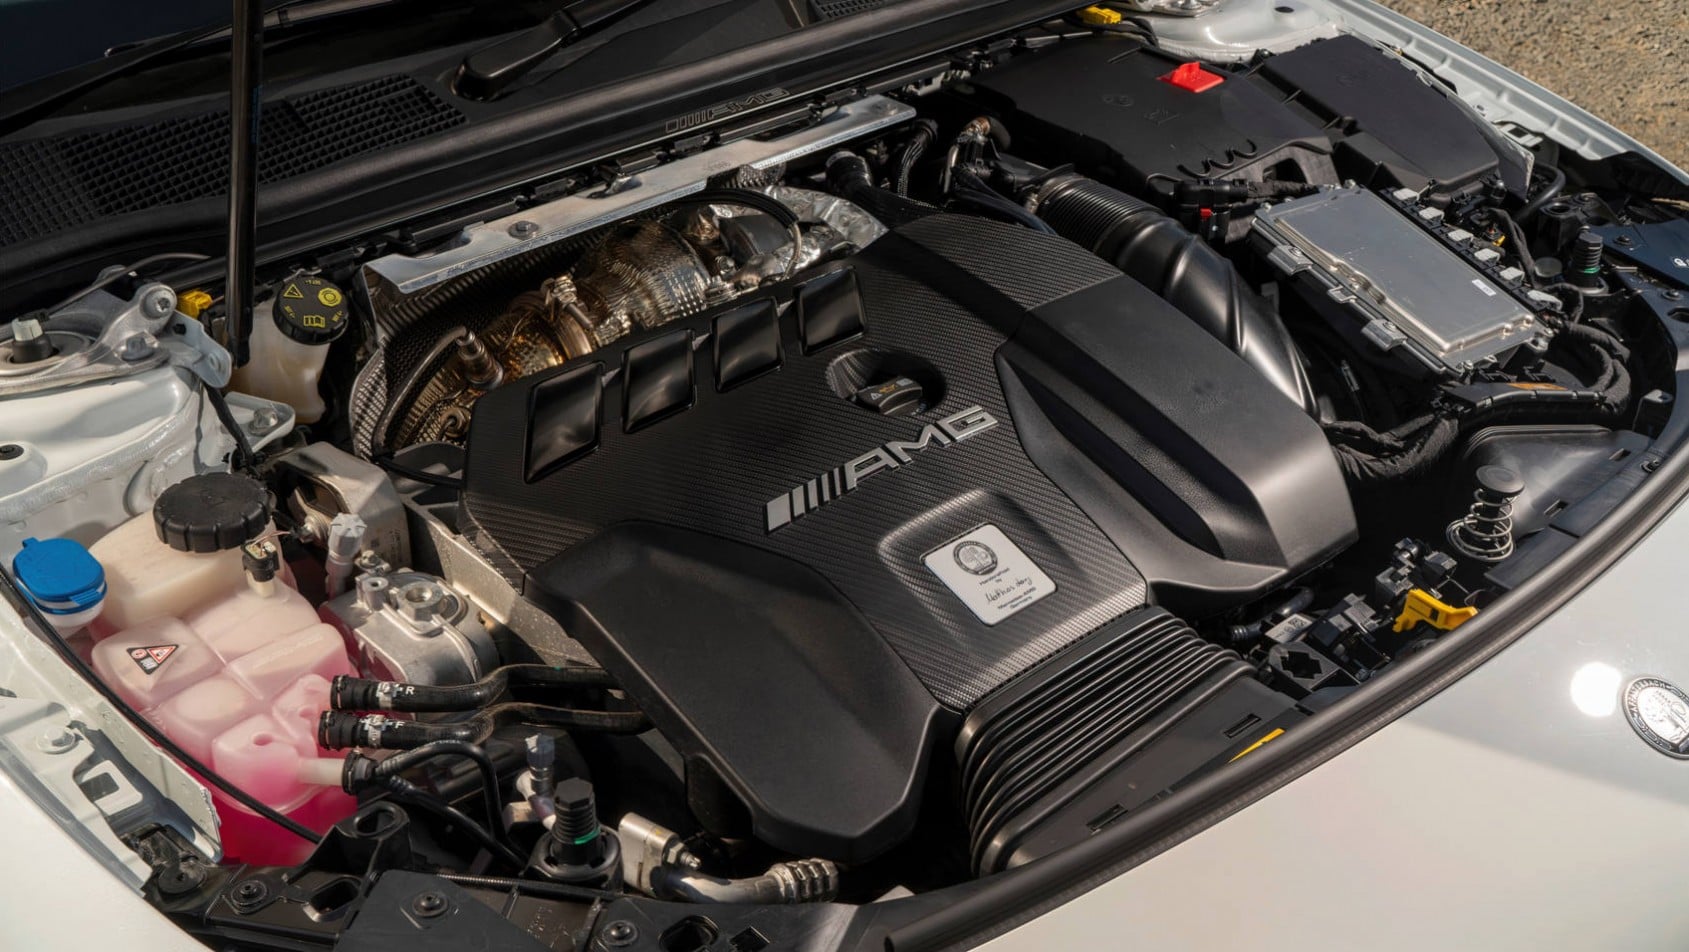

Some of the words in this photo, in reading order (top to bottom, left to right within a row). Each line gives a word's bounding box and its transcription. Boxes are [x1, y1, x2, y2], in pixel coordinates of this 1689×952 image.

[843, 405, 998, 491] AMG
[405, 686, 415, 695] R
[394, 721, 405, 729] F
